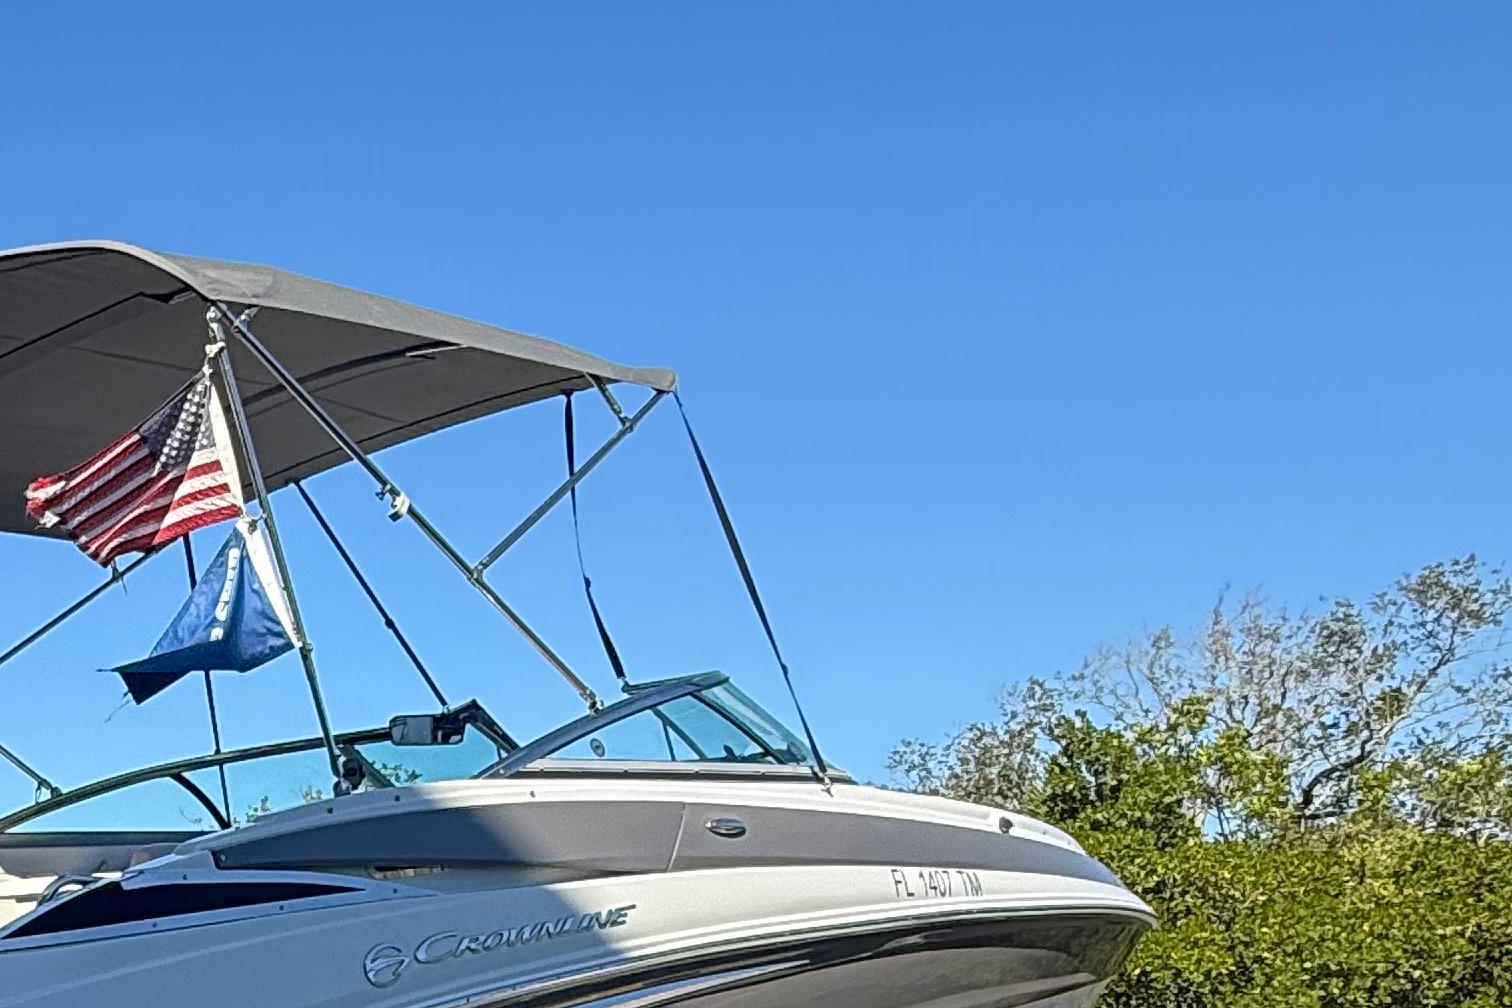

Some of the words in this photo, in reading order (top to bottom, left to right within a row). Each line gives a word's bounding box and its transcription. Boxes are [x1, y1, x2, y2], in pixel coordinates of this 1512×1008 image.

[891, 869, 915, 898] FL
[919, 870, 952, 897] 1407
[956, 870, 983, 897] TM
